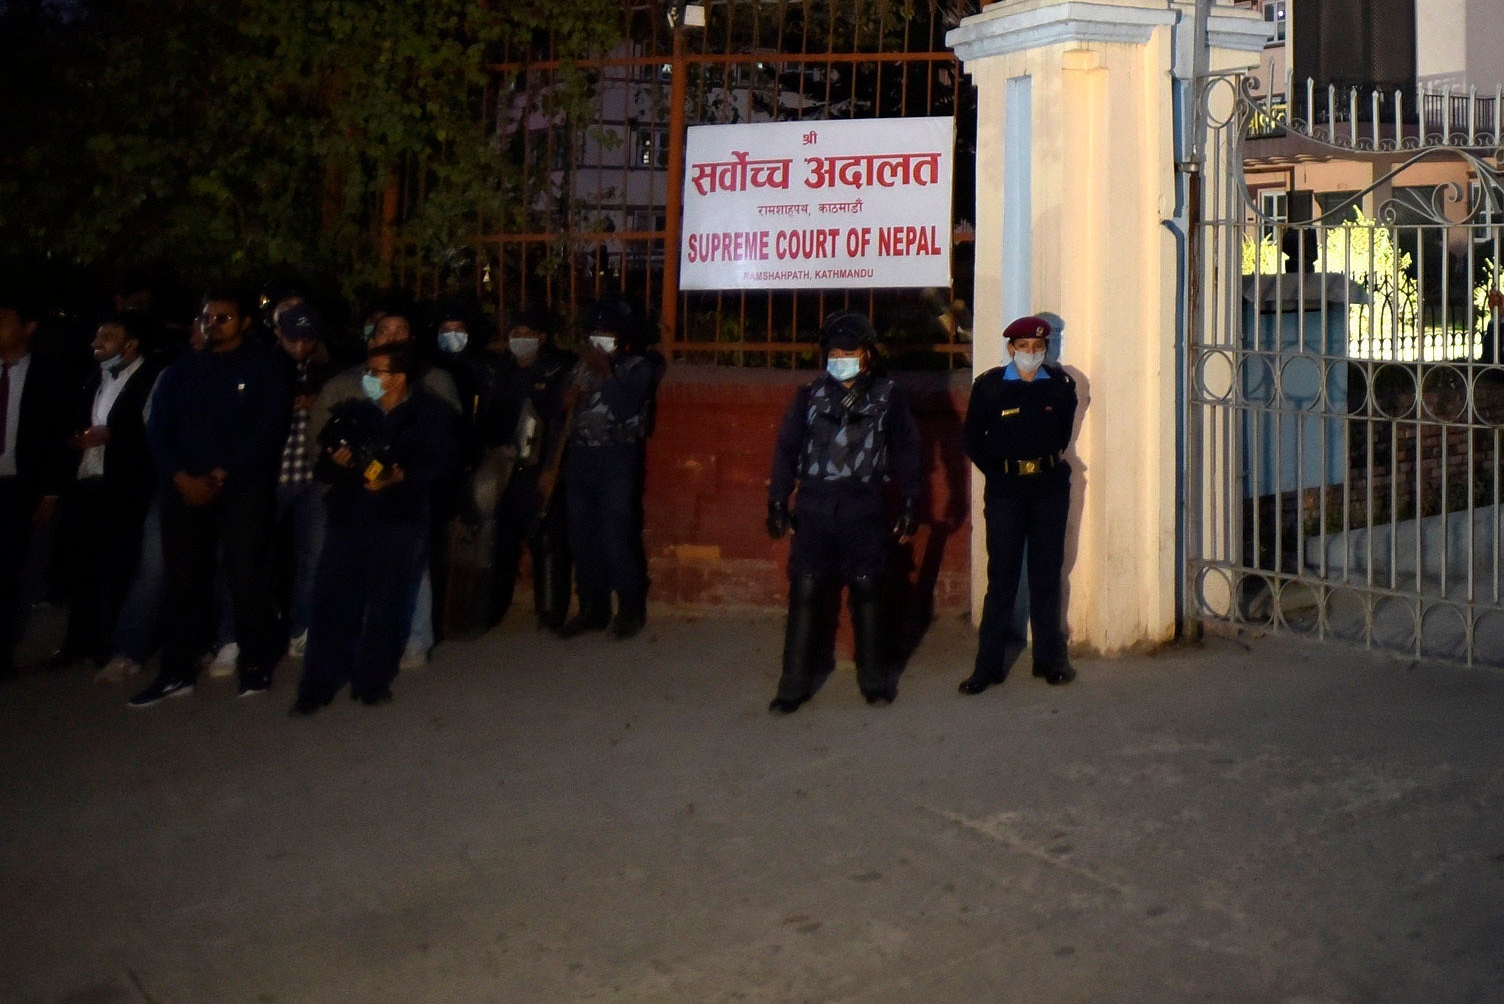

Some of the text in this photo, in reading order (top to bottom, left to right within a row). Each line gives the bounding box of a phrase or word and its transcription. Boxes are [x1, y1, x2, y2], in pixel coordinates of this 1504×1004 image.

[803, 130, 817, 145] श्री
[692, 151, 942, 196] सर्वोच्च अदालत
[688, 225, 942, 263] SUPREME COURT OF NEPAL
[743, 269, 874, 281] RAMSHAHPATH, KATHMANDU
